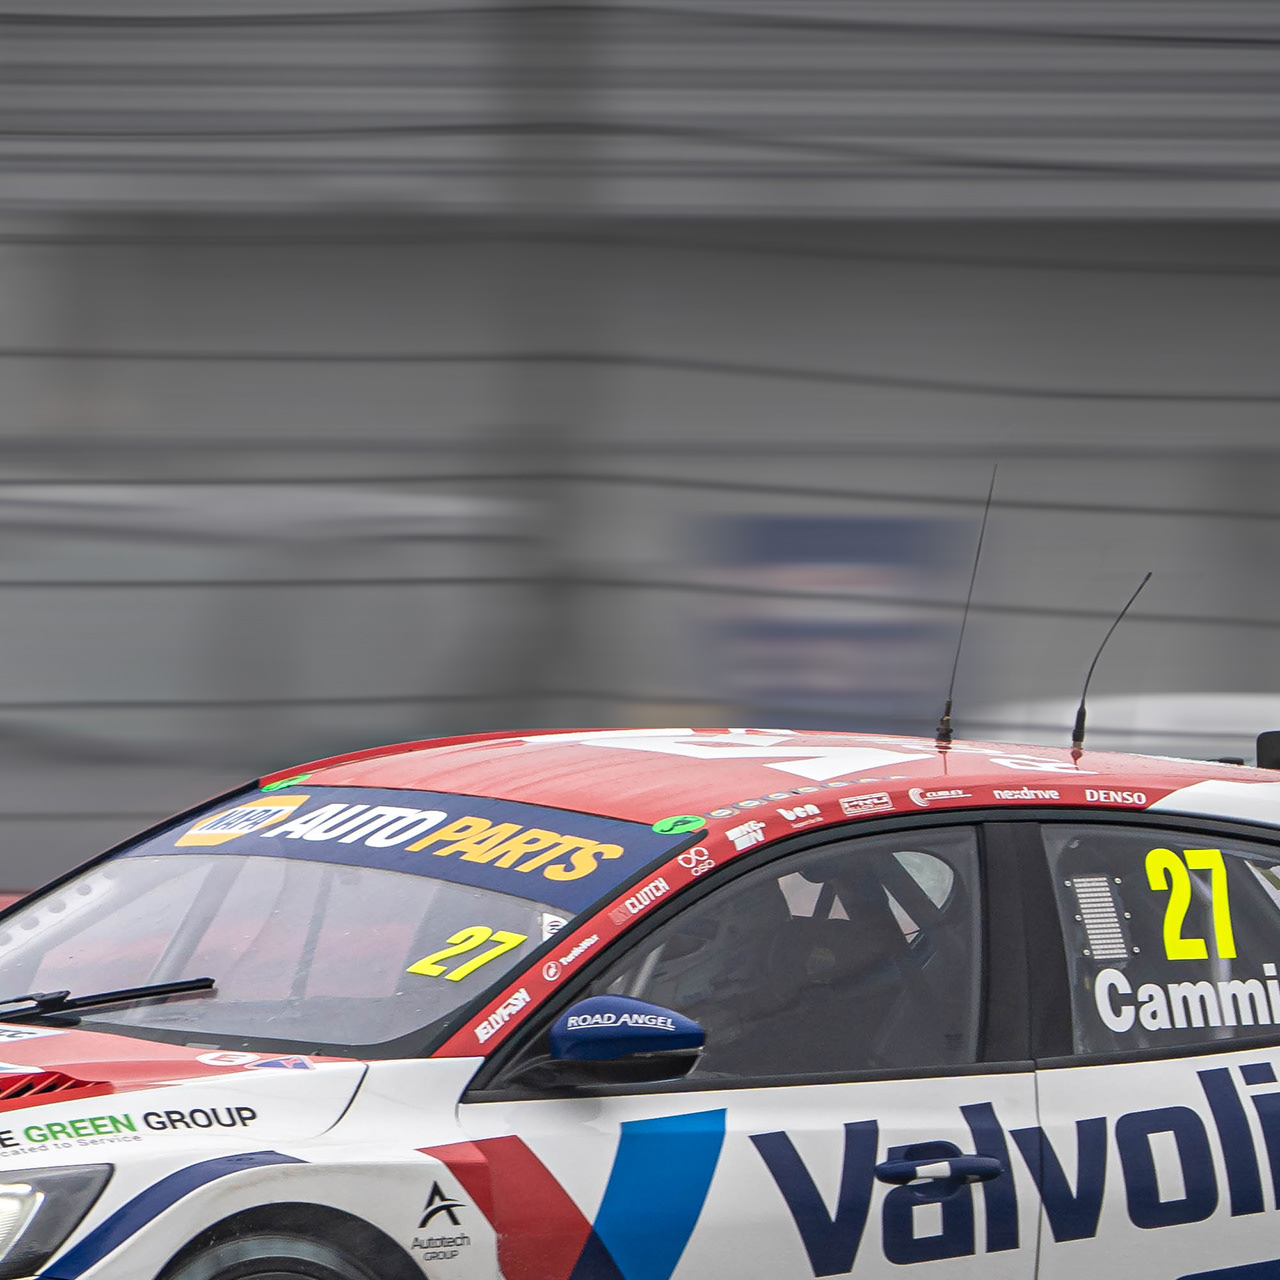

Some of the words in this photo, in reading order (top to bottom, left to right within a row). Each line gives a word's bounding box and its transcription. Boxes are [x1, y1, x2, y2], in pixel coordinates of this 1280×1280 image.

[993, 786, 1060, 800] nexdrive
[1085, 789, 1147, 804] DENSO
[199, 808, 283, 832] NAPA
[260, 803, 449, 848] AUTO
[405, 816, 625, 882] PARTS
[1145, 848, 1237, 961] 27
[406, 926, 528, 981] 27
[567, 1014, 616, 1028] ROAD
[619, 1013, 676, 1030] ANGEL
[23, 1113, 137, 1144] GREEN
[143, 1107, 258, 1132] GROUP
[53, 1138, 74, 1151] to
[77, 1133, 144, 1149] Service
[411, 1233, 471, 1250] Autotech
[423, 1250, 460, 1261] GROUP
